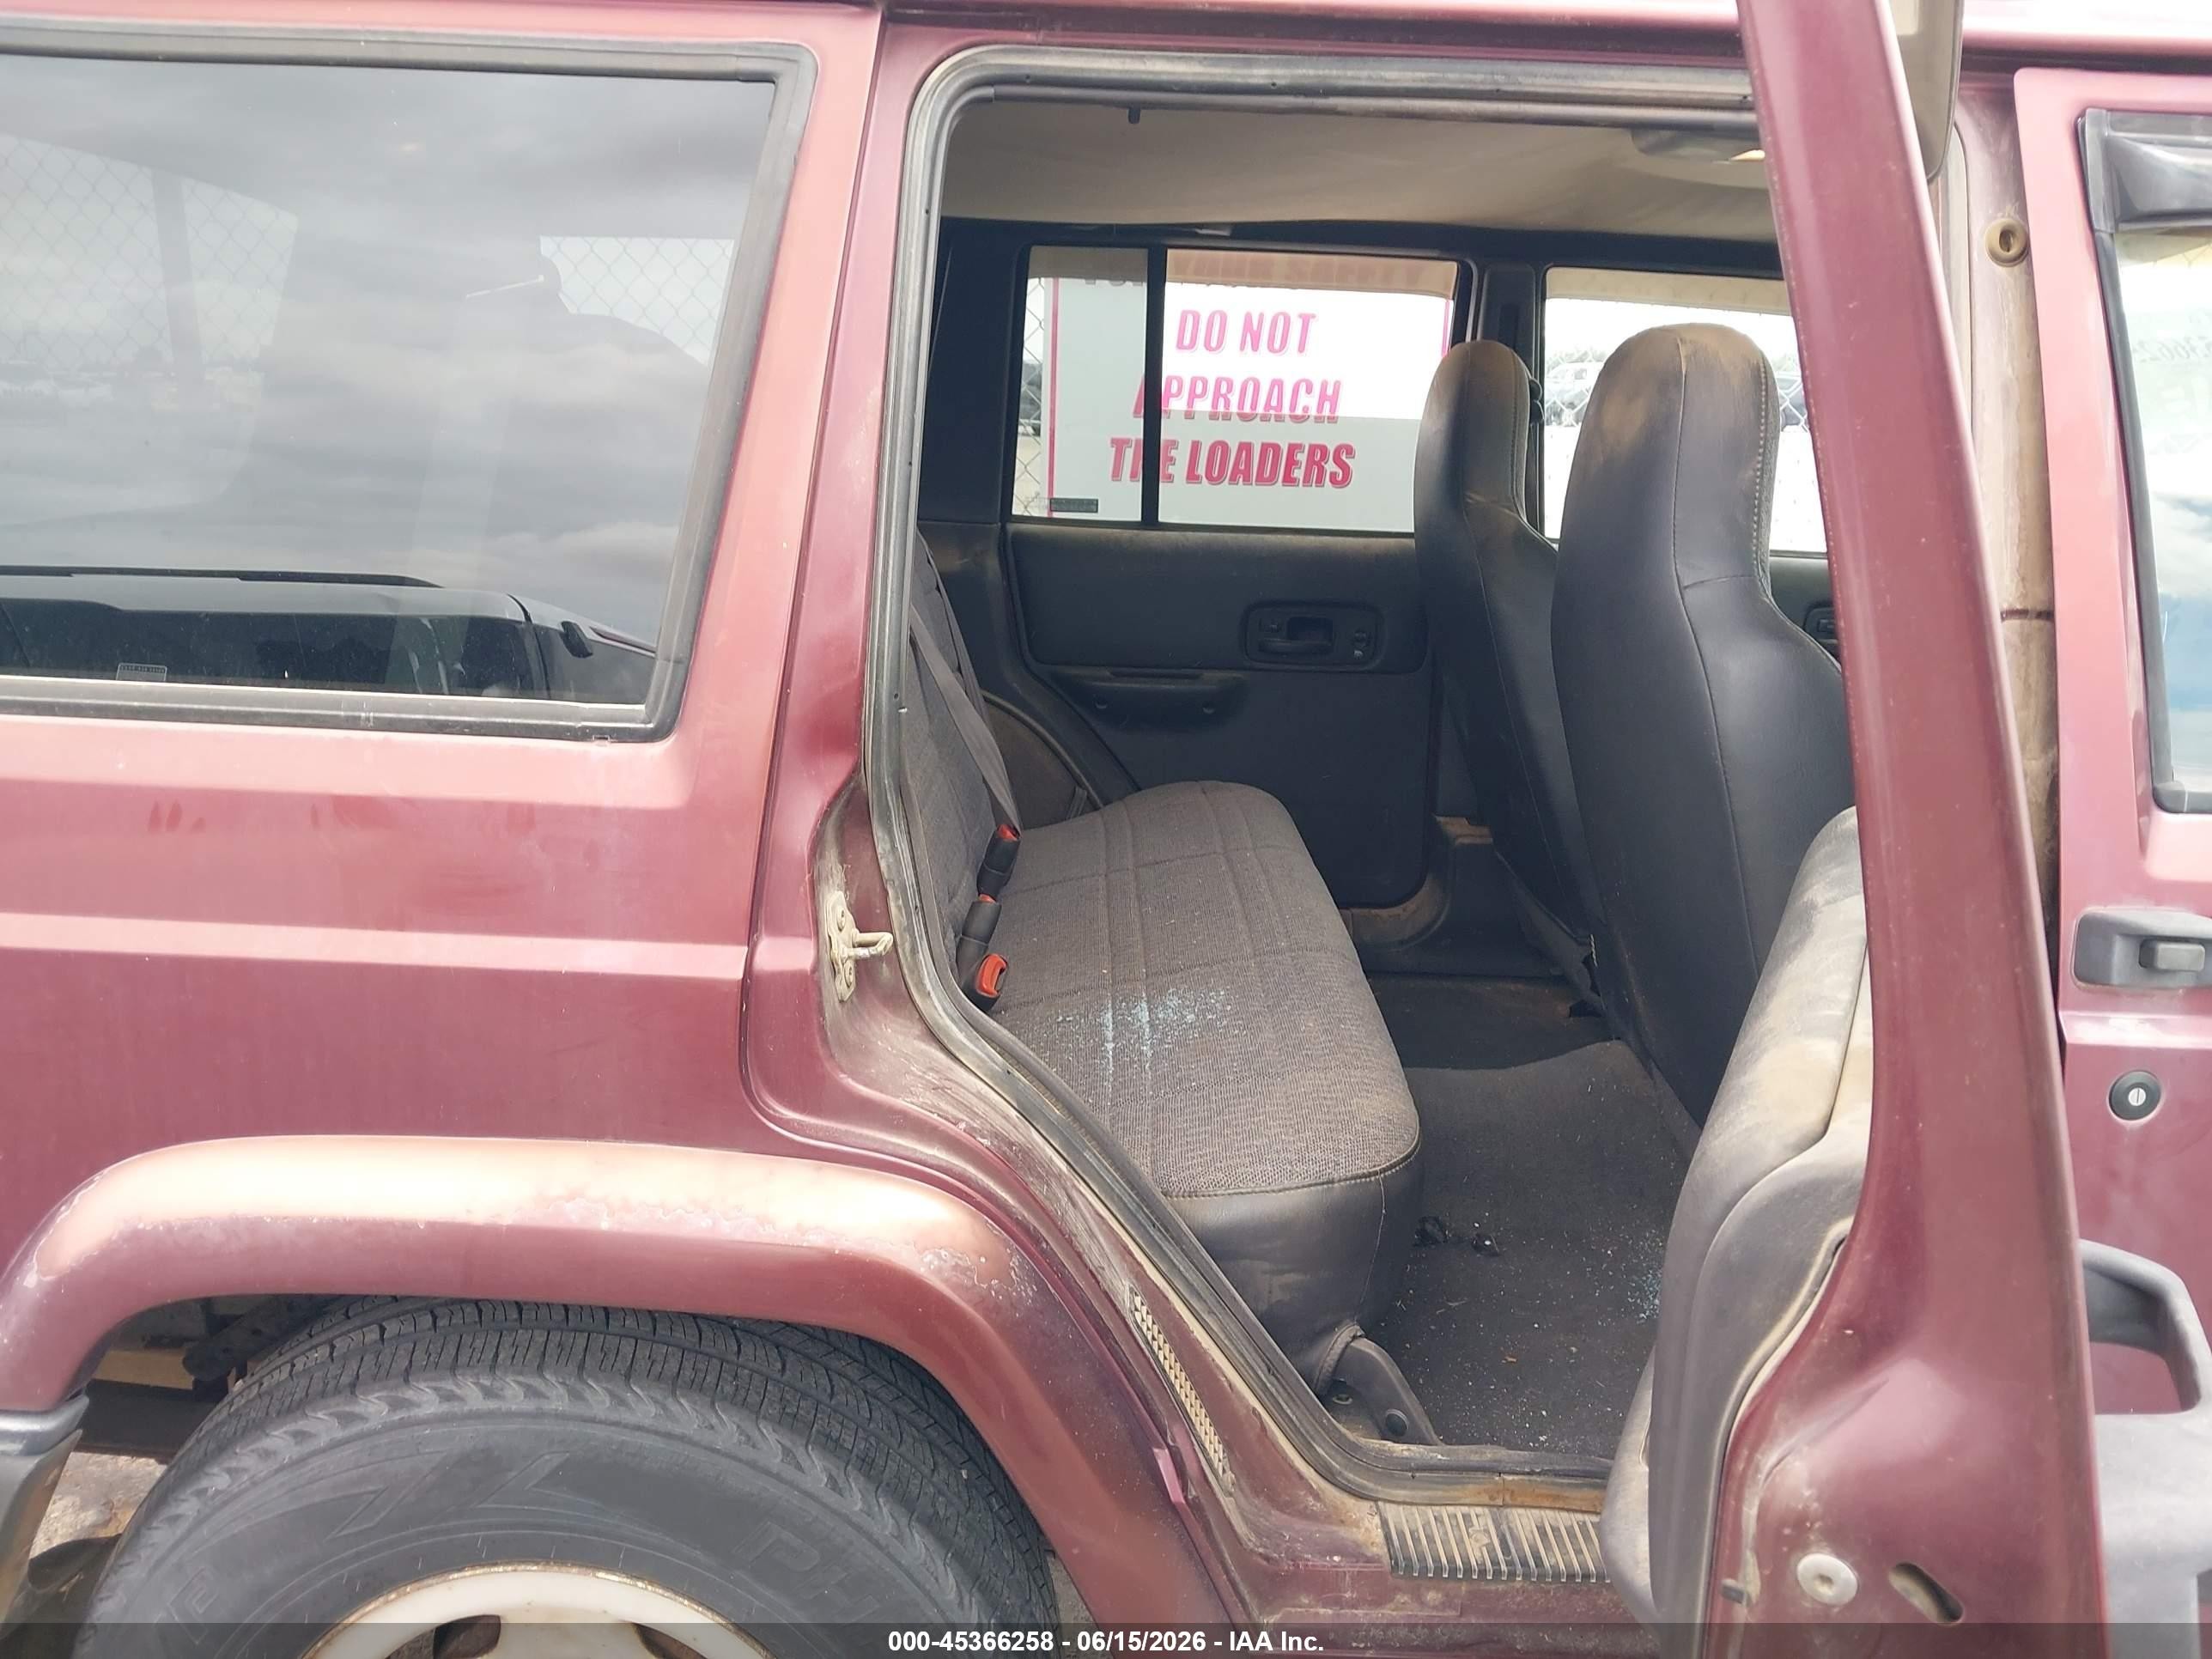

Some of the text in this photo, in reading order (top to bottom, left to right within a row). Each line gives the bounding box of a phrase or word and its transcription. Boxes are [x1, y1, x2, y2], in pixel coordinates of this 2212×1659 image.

[1176, 310, 1317, 355] DO NOT
[1185, 439, 1356, 489] LOADERS
